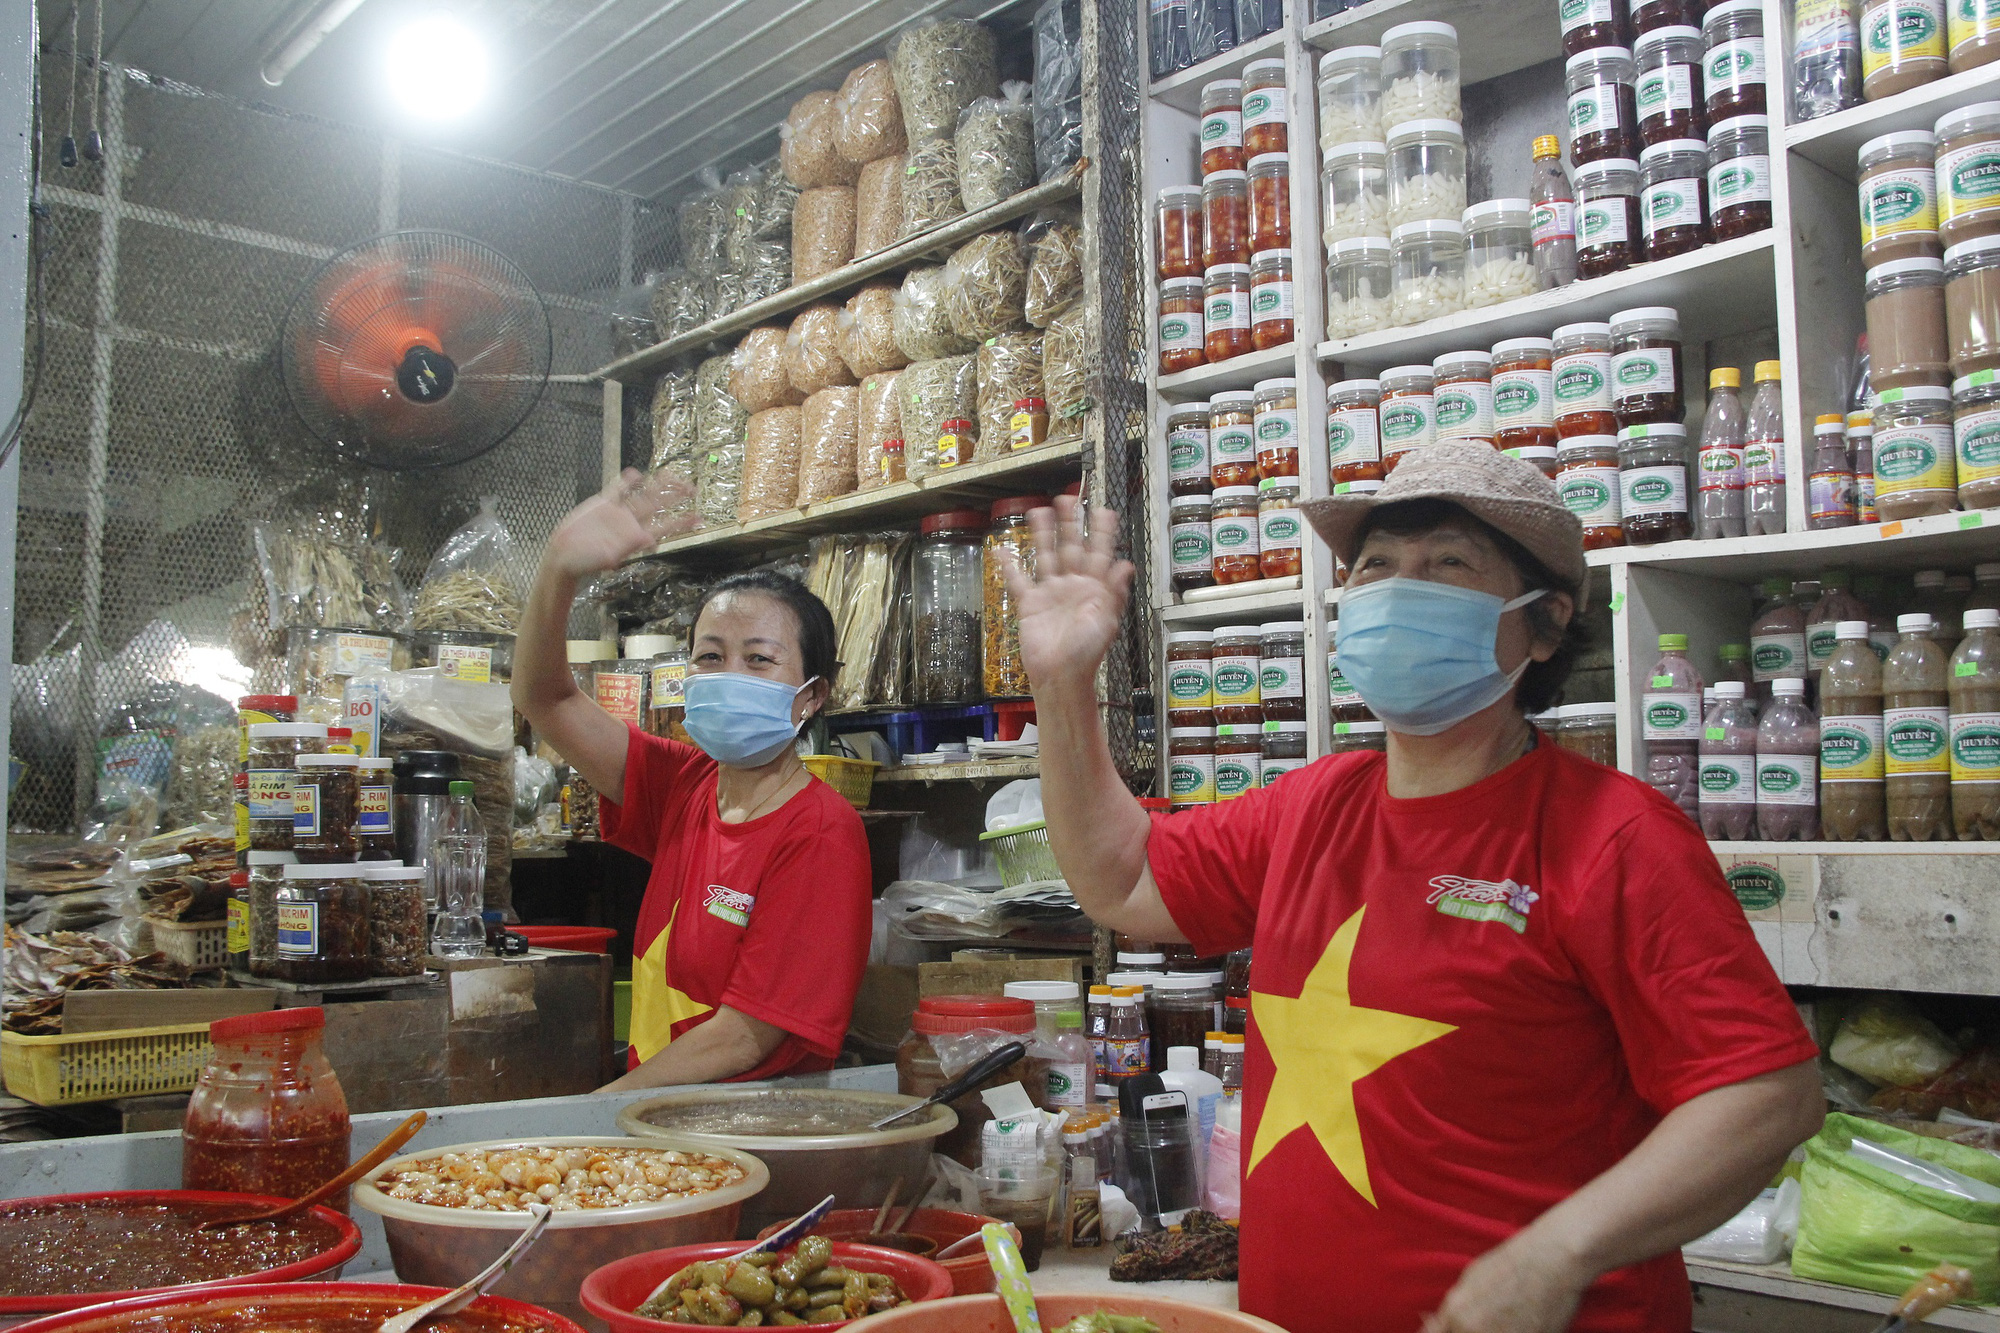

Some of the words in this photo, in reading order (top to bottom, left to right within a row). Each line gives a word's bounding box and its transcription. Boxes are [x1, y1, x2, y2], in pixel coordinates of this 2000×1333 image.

[1882, 16, 1919, 34] HYỀN
[260, 782, 286, 790] RIM
[297, 791, 310, 802] RIM
[369, 792, 387, 801] RIM
[292, 908, 309, 919] RIM
